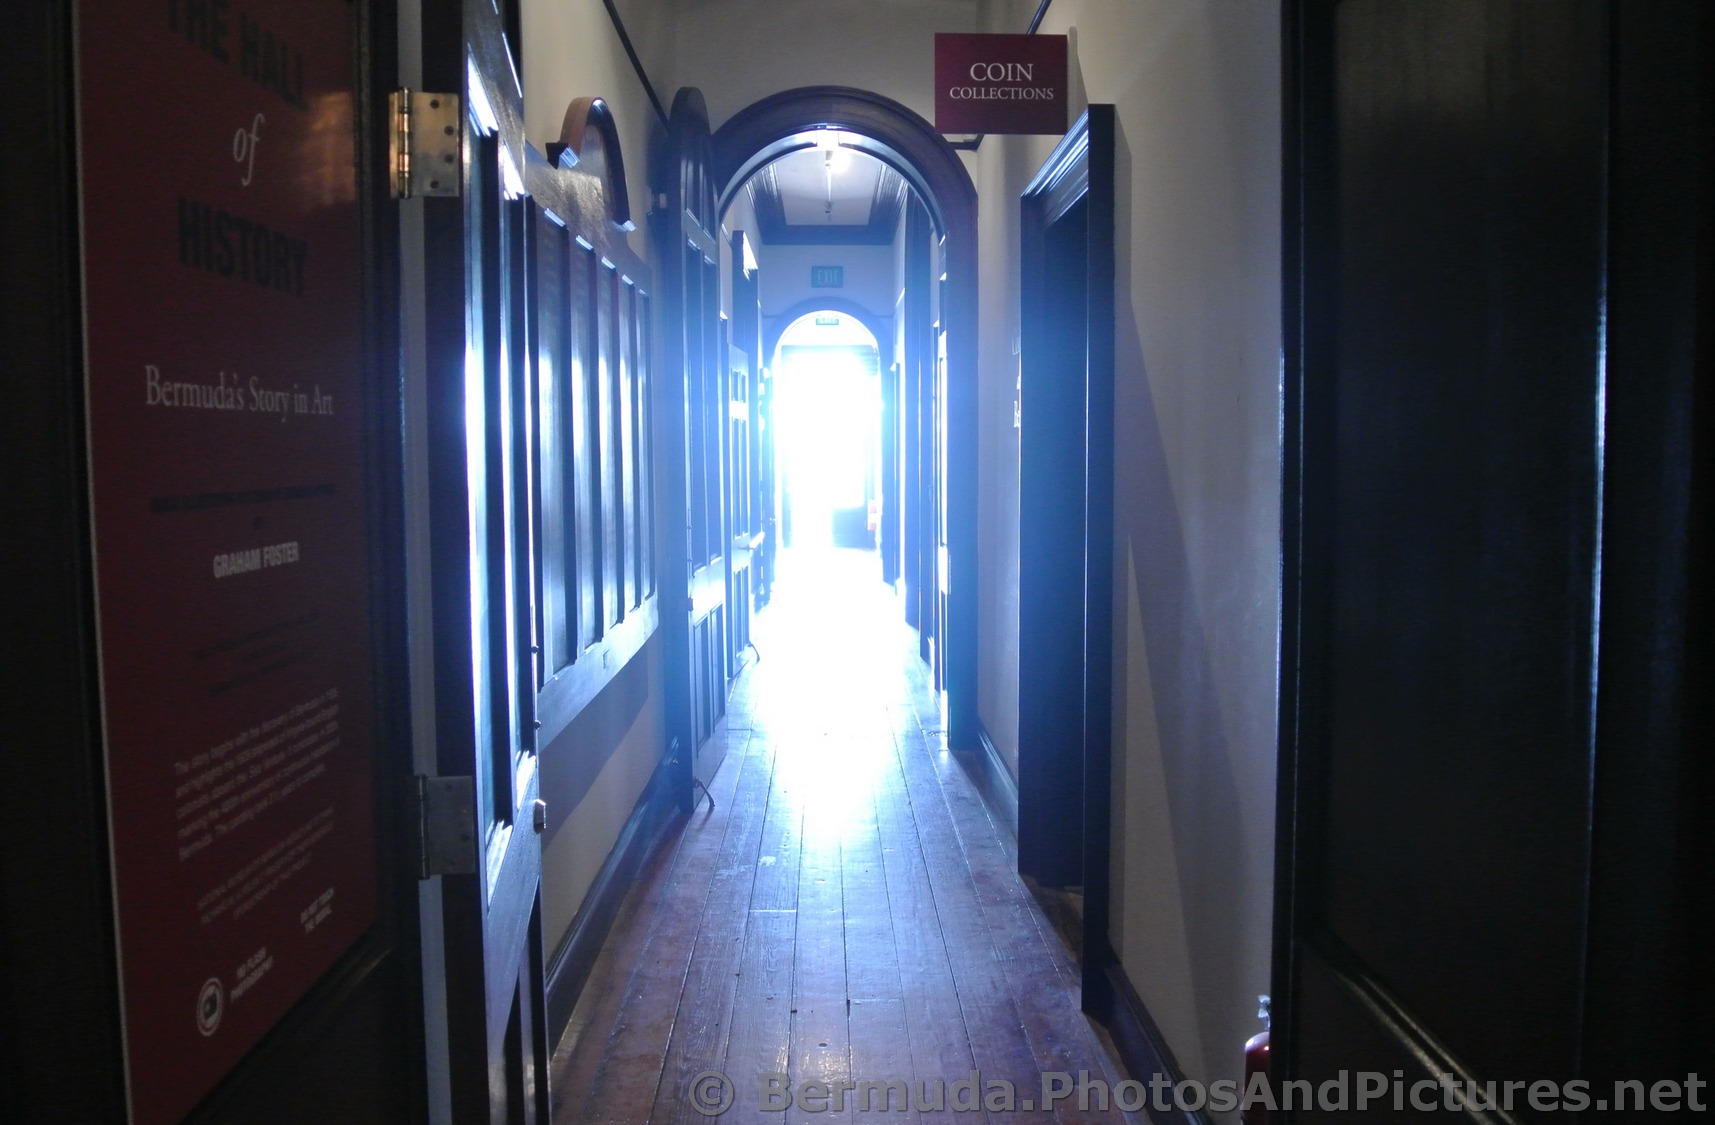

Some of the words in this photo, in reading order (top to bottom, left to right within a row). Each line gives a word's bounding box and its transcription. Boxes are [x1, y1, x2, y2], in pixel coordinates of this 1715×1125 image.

[240, 13, 309, 112] HALL
[969, 62, 1034, 82] COIN
[949, 86, 1055, 100] COLLECTIONS
[232, 112, 265, 187] of
[177, 199, 307, 297] HISTORY
[817, 269, 839, 285] EXIT
[145, 364, 245, 411] Bermuda's
[249, 375, 291, 424] Story
[294, 383, 308, 414] in
[311, 384, 335, 416] Art
[212, 547, 262, 579] GRAHAM
[262, 540, 301, 569] FOSTER
